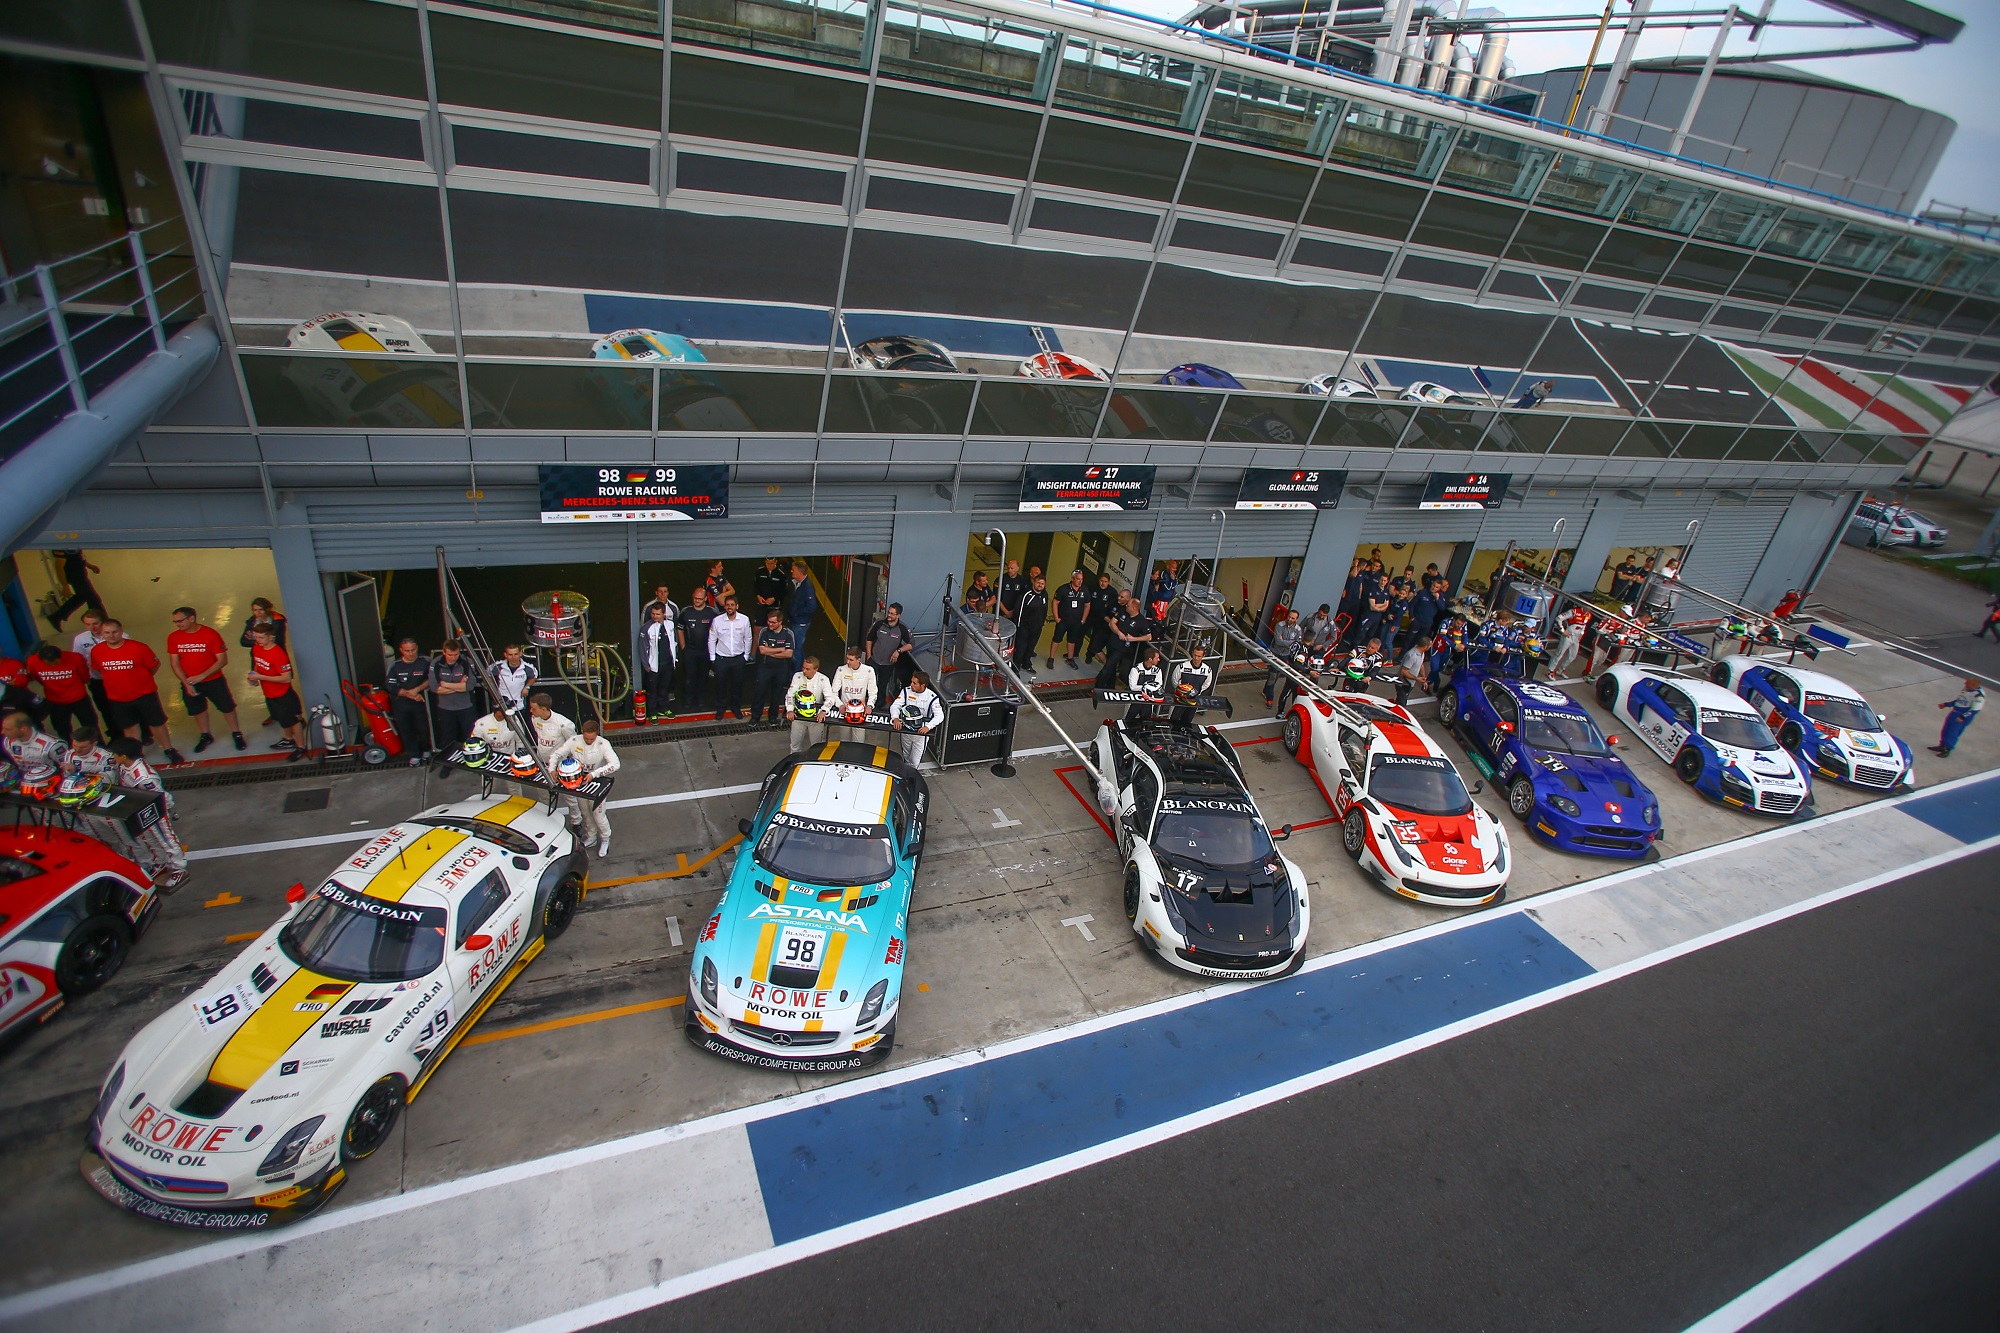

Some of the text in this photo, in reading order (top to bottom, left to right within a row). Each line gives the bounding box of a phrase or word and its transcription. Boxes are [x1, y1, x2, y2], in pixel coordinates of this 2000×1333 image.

[599, 469, 676, 483] 98 99
[1104, 468, 1119, 479] 17
[1306, 472, 1319, 482] 25
[1477, 475, 1488, 484] 14
[598, 485, 677, 496] ROWE RACING
[1037, 482, 1141, 490] INSIGHT RACING DENMARK
[563, 495, 710, 507] MERCEDES-BENZ SLS AMG GT3
[1520, 598, 1536, 613] 14
[1815, 696, 1864, 707] BLANCPAIN
[1534, 710, 1588, 722] BLANCPAIN
[1711, 711, 1760, 723] BLANCPAIN
[953, 729, 1007, 741] INSIGHTRACING
[1640, 724, 1675, 758] DERICHEBOURG
[1667, 729, 1683, 748] 35
[1722, 748, 1739, 760] 35
[1384, 756, 1445, 769] BLANCPAIN
[1162, 799, 1254, 814] BLANCPAIN
[772, 813, 873, 836] 98 BLANCPAIN
[1397, 827, 1420, 841] 25
[352, 827, 403, 868] ROWE
[361, 844, 393, 870] MOTOR
[435, 845, 477, 882] MOTOR OIL
[1442, 857, 1468, 865] Glorax
[440, 847, 489, 890] ROWE
[1172, 867, 1204, 881] BLANCPAIN
[793, 885, 810, 894] PRO
[1177, 873, 1198, 892] 17
[321, 883, 424, 922] 99 BLANCPAIN
[748, 903, 869, 934] ASTANA
[770, 919, 846, 932] PRESIDENTIAL CLUB
[704, 912, 721, 942] TAK
[785, 930, 823, 939] BLANCPAIN
[470, 917, 520, 985] ROWE
[785, 938, 816, 963] 98
[884, 935, 901, 964] TAK
[895, 940, 905, 965] GROUP
[470, 955, 504, 993] MOTOR
[505, 937, 520, 954] OIL
[1200, 967, 1269, 978] INSIGHTRACING
[235, 983, 254, 1011] BLANCPAIN
[751, 984, 828, 1008] ROWE
[202, 993, 240, 1025] 99
[299, 1003, 323, 1011] PRO
[384, 981, 443, 1043] cavefood.nl
[746, 1002, 823, 1020] MOTOR OIL
[321, 1018, 372, 1034] MUSCLE
[340, 1027, 370, 1037] PROTEIN
[704, 1039, 861, 1071] MOTORSPORT COMPETENCE GROUP AG
[250, 1091, 300, 1104] cavefood.nl
[131, 1106, 233, 1152] ROWE
[122, 1132, 207, 1166] MOTOR OIL
[91, 1166, 269, 1226] MOTORSPORT COMPETENCE GROUP AG
